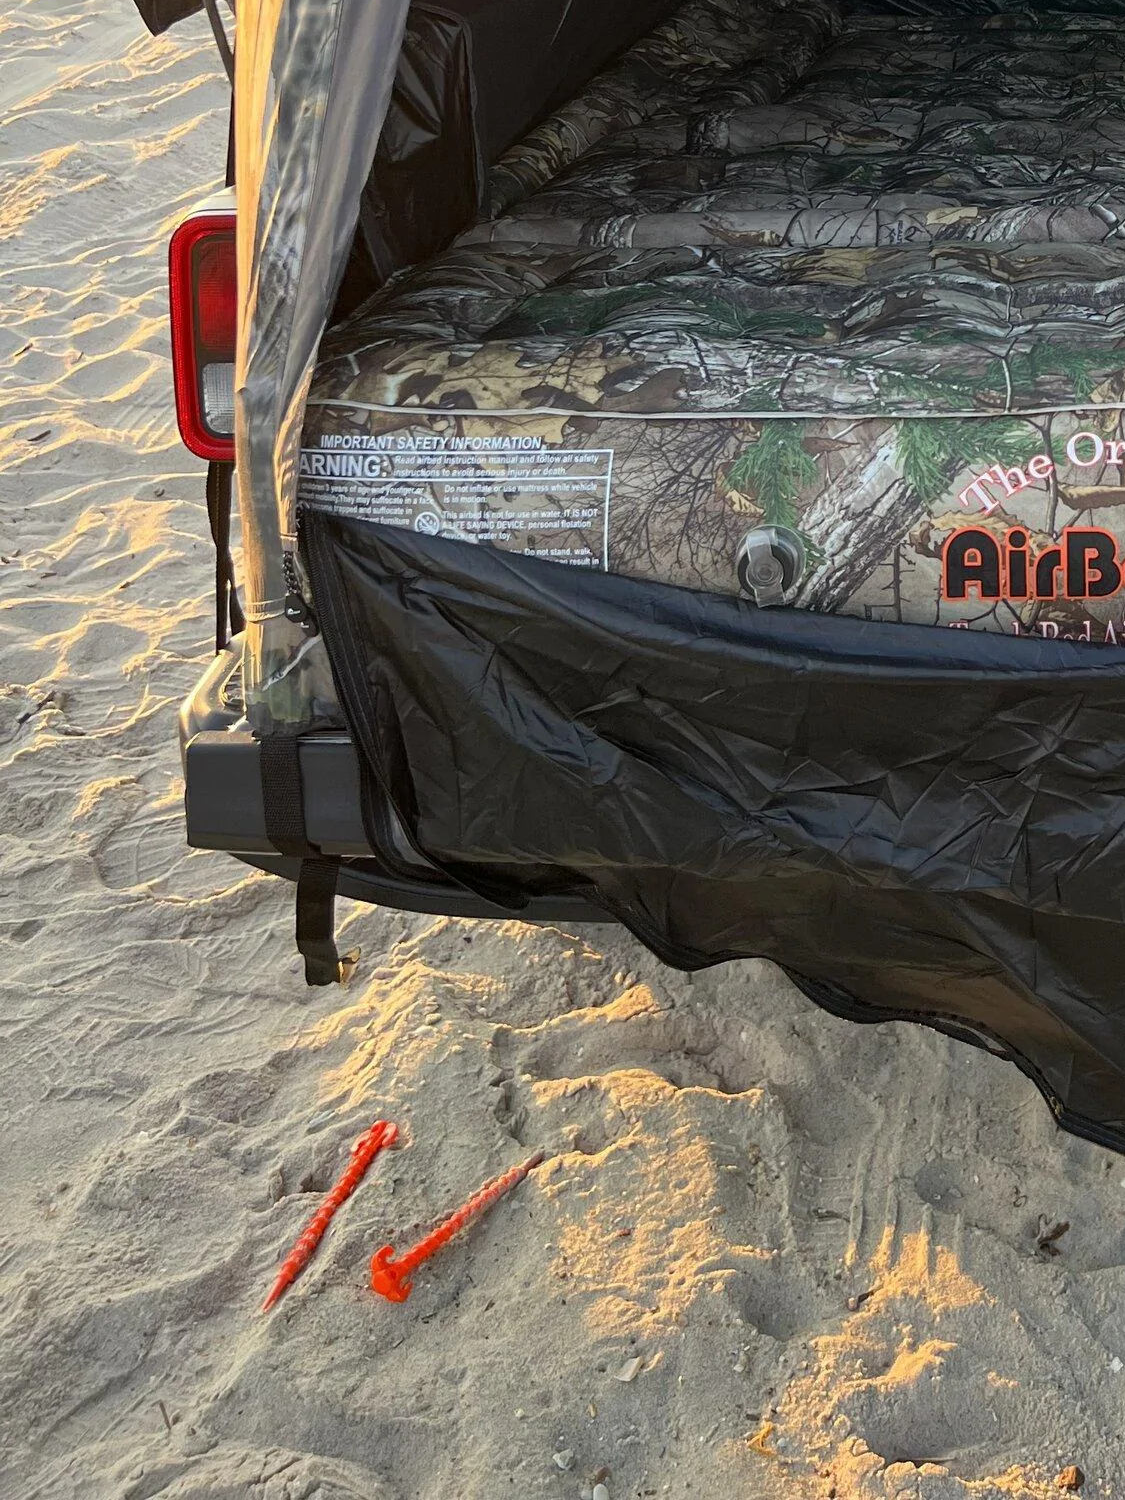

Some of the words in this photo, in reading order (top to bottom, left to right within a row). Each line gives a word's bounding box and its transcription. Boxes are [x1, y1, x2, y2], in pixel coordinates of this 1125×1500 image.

[320, 434, 395, 450] IMPORTANT
[397, 435, 448, 450] SAFETY
[450, 436, 542, 450] INFORMATION
[395, 455, 416, 465] Read
[417, 455, 443, 465] airbed
[489, 455, 518, 464] manual
[519, 455, 536, 464] and
[537, 454, 561, 463] follow
[562, 454, 574, 463] all
[574, 453, 600, 465] safety
[299, 453, 388, 478] ARNING:
[393, 468, 438, 477] instructions
[442, 468, 450, 477] to
[451, 468, 475, 477] avoid
[476, 468, 506, 477] serious
[507, 468, 531, 478] injury
[444, 484, 455, 493] Do
[456, 485, 469, 493] not
[958, 453, 1055, 516] The
[443, 510, 458, 519] This
[572, 509, 581, 518] IS
[528, 519, 560, 530] personal
[524, 548, 535, 556] Do
[536, 548, 549, 556] not
[570, 557, 591, 566] result
[591, 557, 600, 566] in
